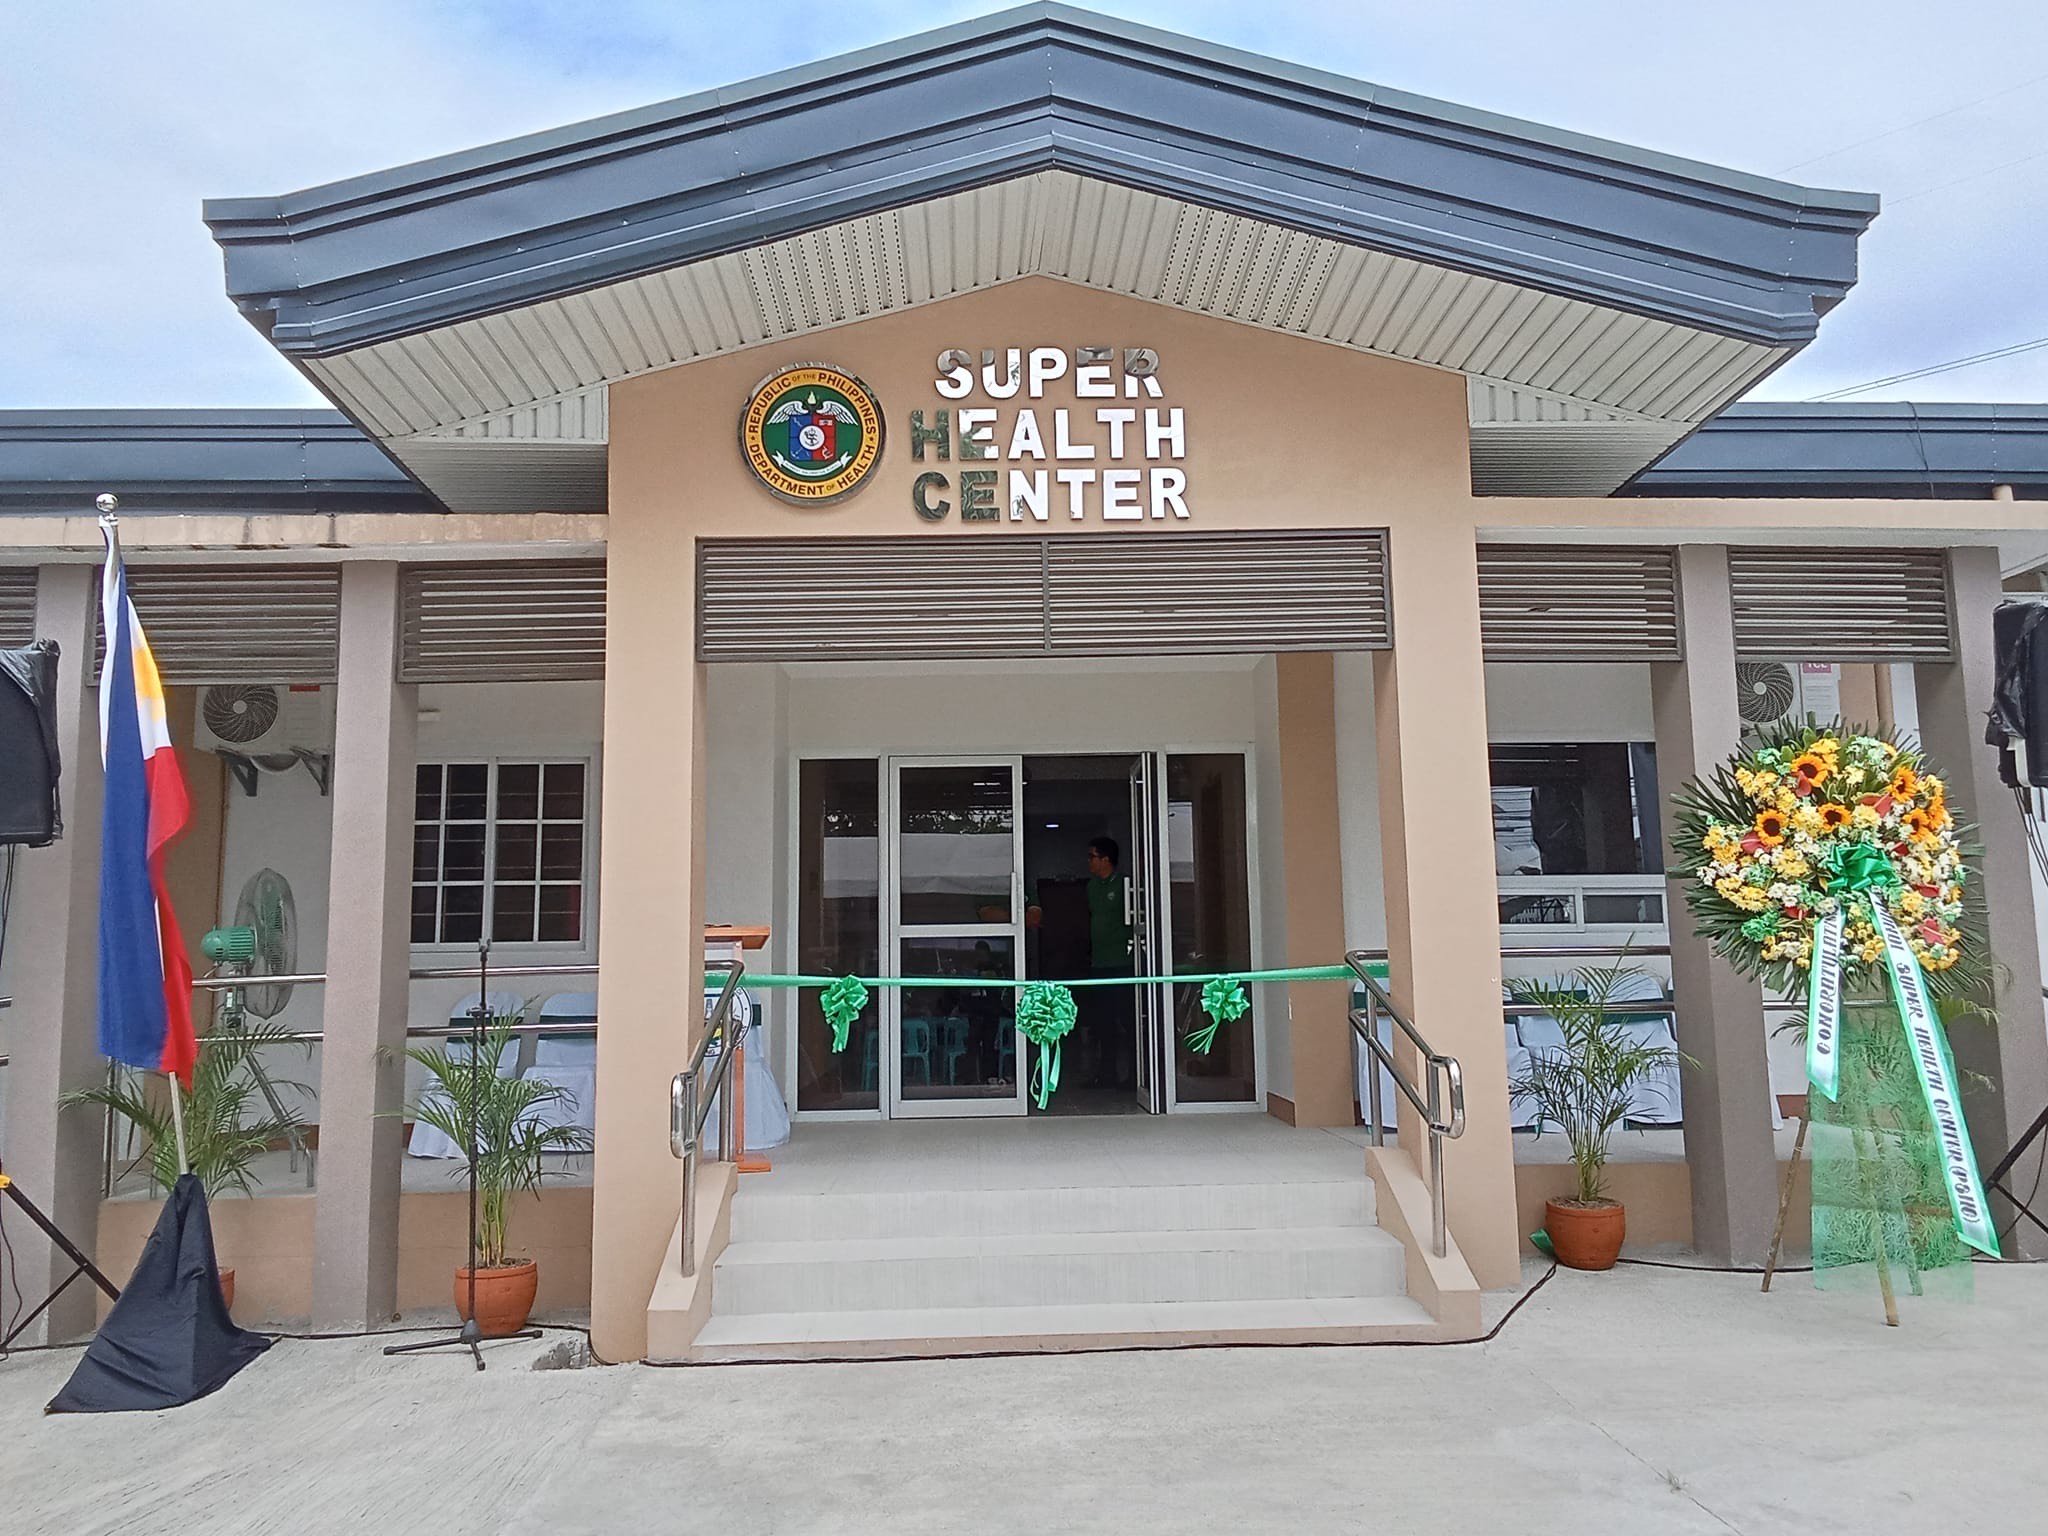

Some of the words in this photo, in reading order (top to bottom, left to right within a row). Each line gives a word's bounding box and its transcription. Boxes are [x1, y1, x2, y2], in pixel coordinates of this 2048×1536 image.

[934, 347, 1164, 399] SUPER
[748, 376, 792, 431] REPUBLIC
[818, 372, 877, 434] PHILIPPINES
[910, 407, 1185, 462] HEALTH
[749, 444, 825, 496] DEPARTMENT
[836, 445, 876, 489] HEALTH
[912, 467, 1191, 522] CENTER
[1895, 960, 1925, 1024] SUPER
[1914, 1026, 1945, 1092] HEALTH
[1934, 1098, 1964, 1164] CENTER
